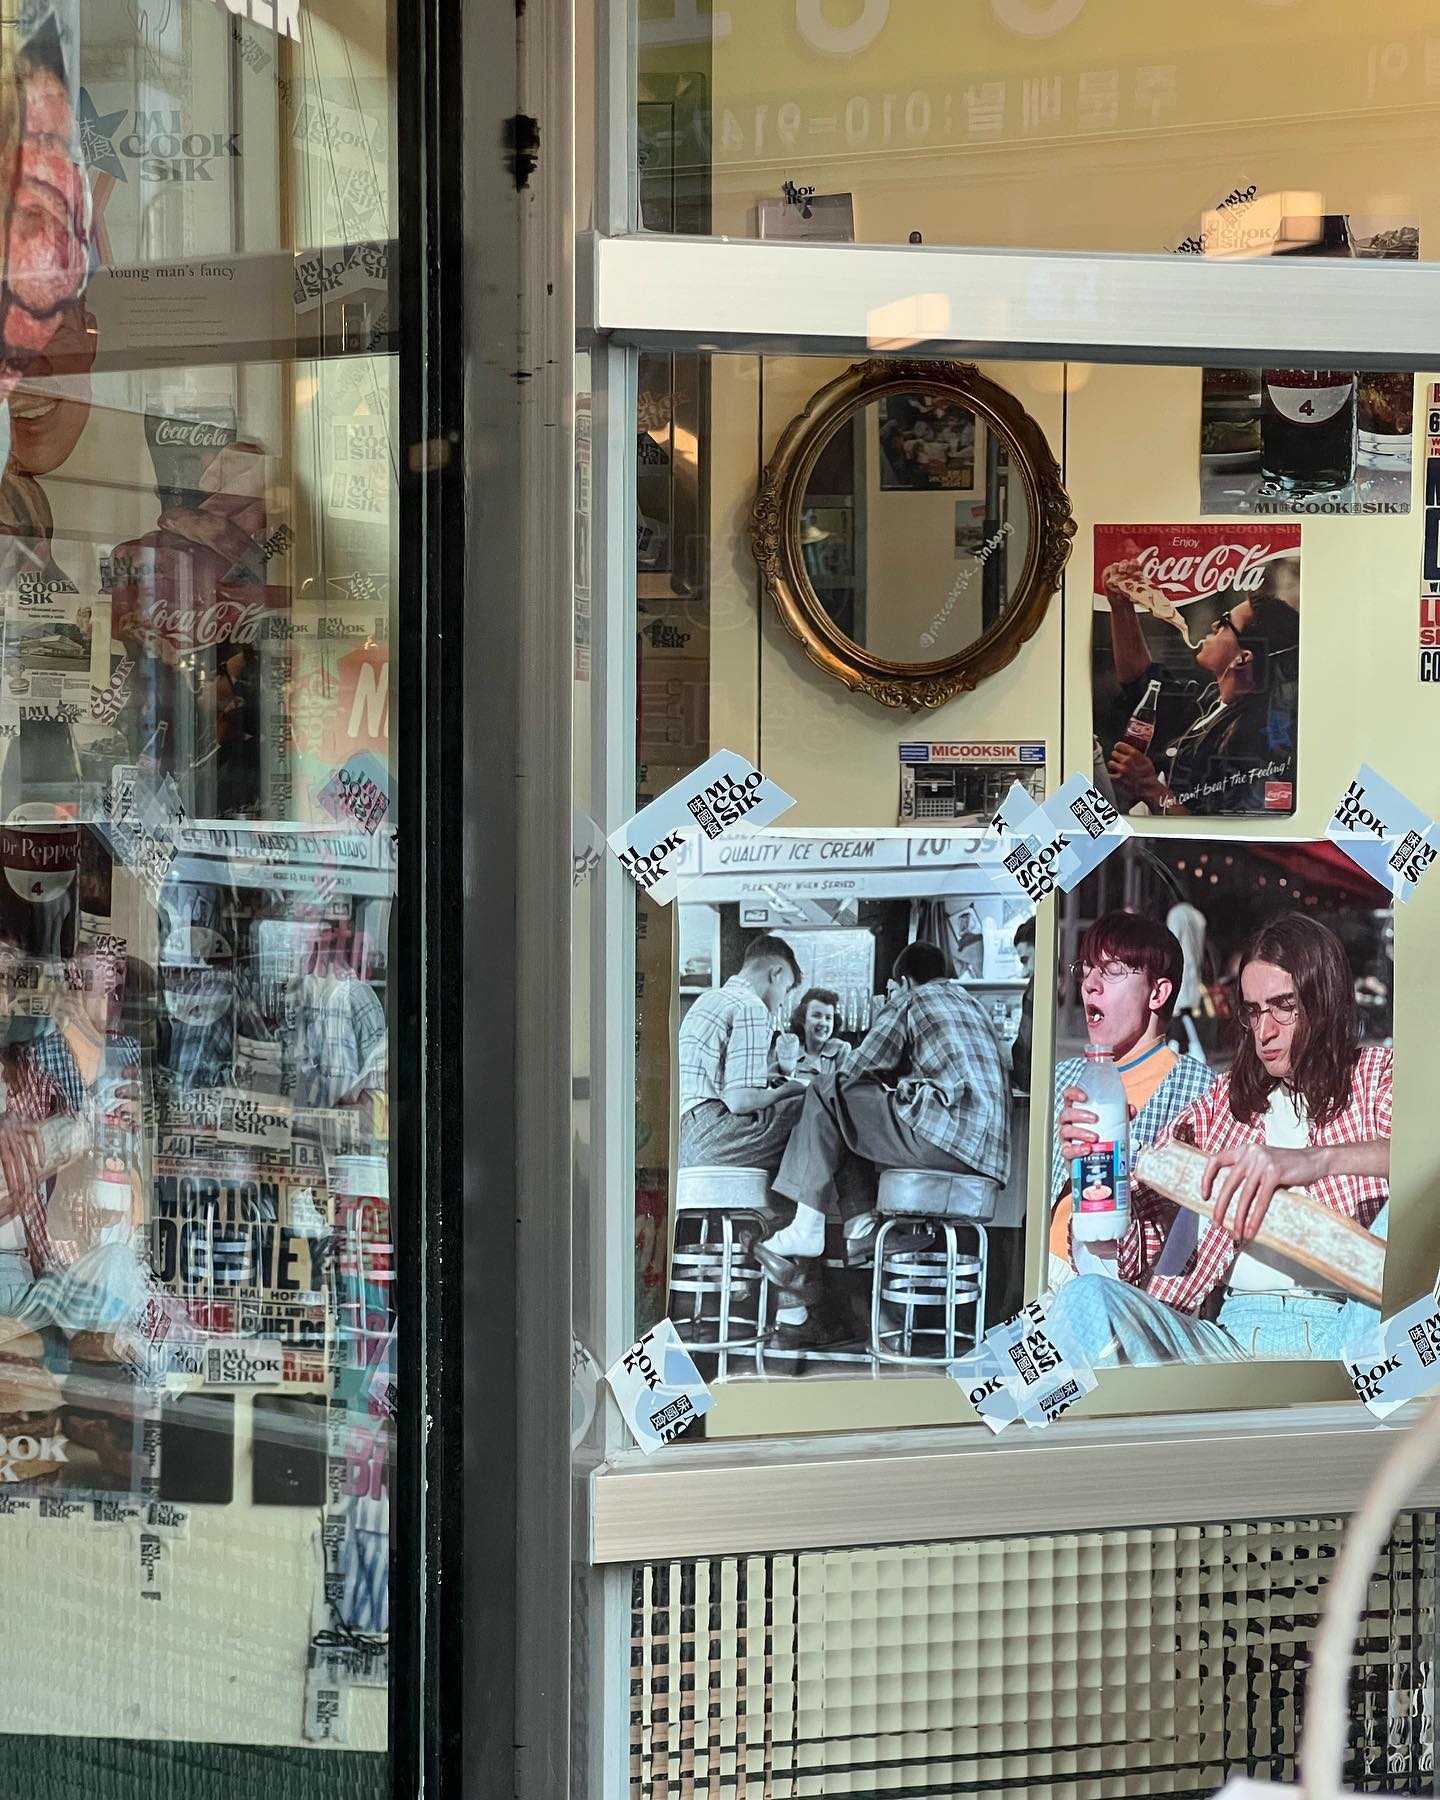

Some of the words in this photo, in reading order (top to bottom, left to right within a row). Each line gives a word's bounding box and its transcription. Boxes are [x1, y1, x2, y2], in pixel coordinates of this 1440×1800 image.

[132, 110, 182, 134] MI
[119, 133, 242, 159] COOK
[141, 158, 215, 183] SIK
[107, 265, 150, 282] Young
[155, 264, 196, 279] man's
[199, 263, 237, 280] fancy
[300, 258, 323, 278] MI
[303, 255, 361, 286] COOK
[307, 275, 344, 299] SIK
[1298, 400, 1315, 416] 4
[155, 420, 229, 447] Coca-Cola
[1172, 536, 1200, 550] Enjoy
[18, 571, 42, 584] MI
[1136, 543, 1272, 592] Coca-Cola
[18, 579, 80, 594] COOK
[19, 593, 55, 606] SIK
[149, 598, 267, 647] Coca-Cola
[326, 623, 366, 633] COOK
[91, 656, 136, 721] COOK
[28, 705, 49, 716] MI
[101, 690, 132, 727] SIK
[931, 745, 1017, 757] MICOOKSIK
[704, 773, 737, 804] MI
[1178, 784, 1203, 805] can't
[1202, 776, 1230, 796] beat
[1228, 772, 1247, 787] The
[1247, 756, 1292, 785] Feeling!
[688, 796, 724, 840] 味國食
[720, 789, 764, 827] SIK
[1070, 797, 1105, 840] 味國食
[3, 838, 17, 856] Dr
[22, 838, 79, 866] Pepper
[632, 830, 687, 875] OOK
[719, 844, 783, 865] QUALITY
[788, 843, 814, 861] ICE
[820, 840, 876, 860] CREAM
[1389, 830, 1422, 872] 味國食
[31, 881, 44, 896] 4
[796, 882, 819, 890] WHEN
[821, 880, 856, 890] SERVED
[235, 1099, 259, 1115] MI
[234, 1111, 289, 1129] COOK
[234, 1121, 268, 1137] SIK
[157, 1176, 280, 1223] MORTON
[223, 1348, 247, 1360] MI
[1408, 1323, 1438, 1368] 味國食
[222, 1358, 281, 1372] COOK
[222, 1369, 258, 1383] SIK
[1008, 1342, 1040, 1386] 味國食
[650, 1394, 694, 1432] 味國食
[0, 1435, 70, 1463] OK
[103, 1506, 140, 1518] COOK
[159, 1504, 175, 1513] MI
